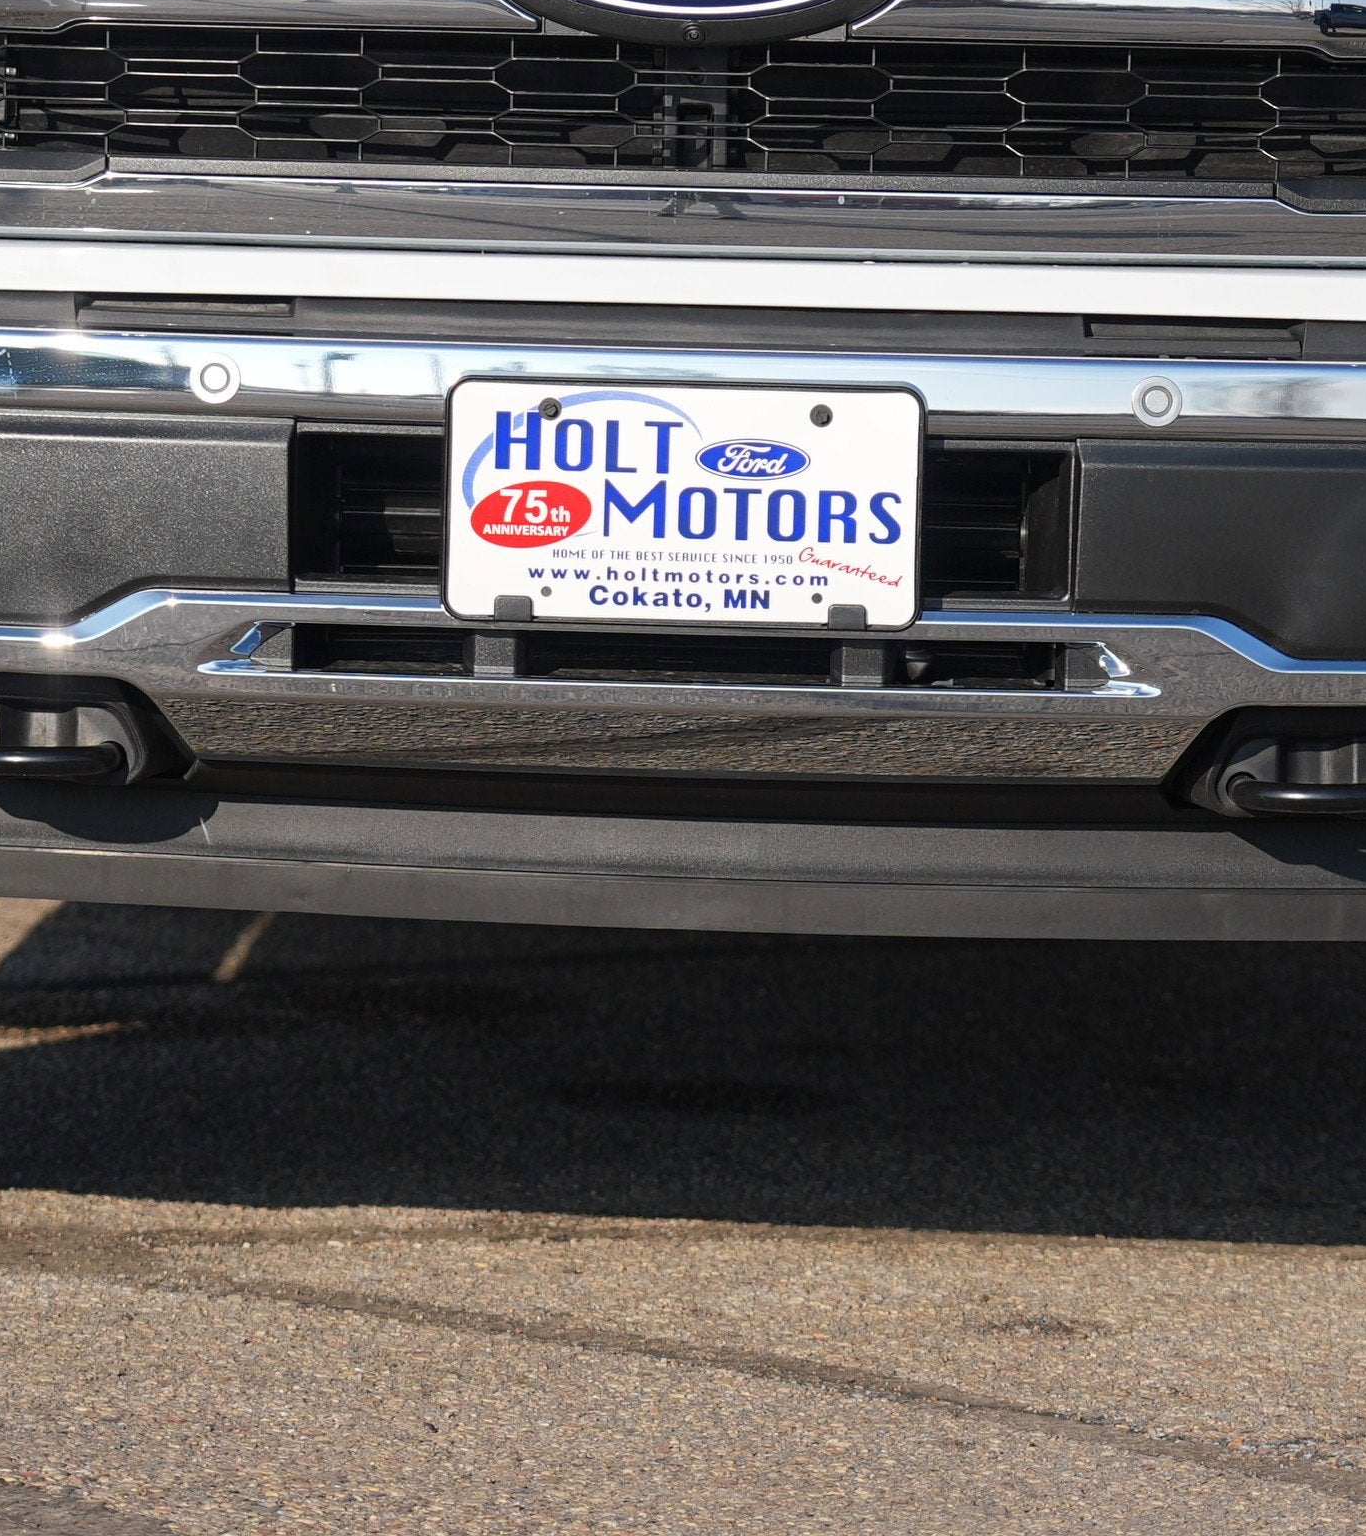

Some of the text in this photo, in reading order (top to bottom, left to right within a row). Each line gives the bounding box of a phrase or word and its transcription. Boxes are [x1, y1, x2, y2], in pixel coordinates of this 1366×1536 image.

[494, 410, 684, 475] HOLT
[717, 443, 789, 474] Ford
[499, 488, 571, 524] 75th
[603, 478, 902, 545] MOTORS
[482, 523, 570, 538] ANNIVERSARY
[552, 548, 793, 565] HOME OF THE BEST SERVICE SINCE 1950
[798, 546, 903, 588] Guaranteed
[528, 566, 828, 587] www.holtmotors.com
[588, 584, 770, 613] Cokato, MN
